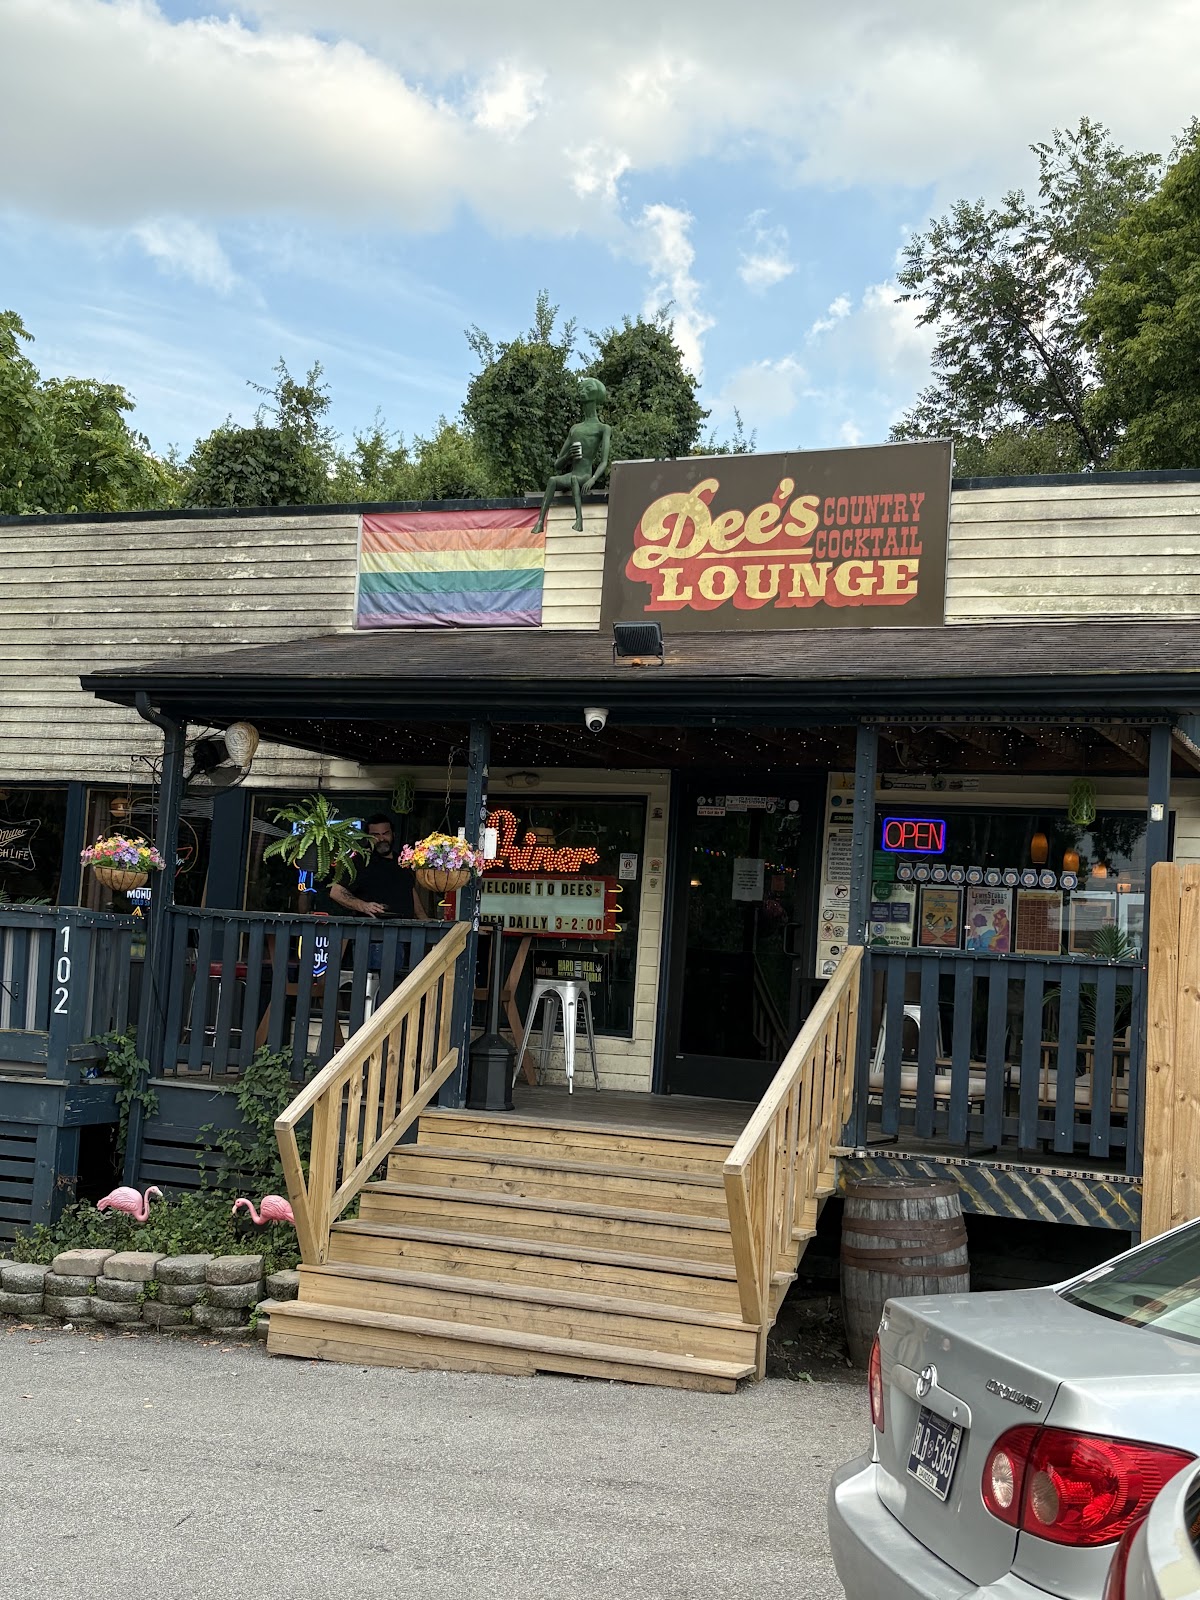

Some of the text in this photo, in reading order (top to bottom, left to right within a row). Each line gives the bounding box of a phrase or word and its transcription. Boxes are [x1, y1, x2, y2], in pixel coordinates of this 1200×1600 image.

[628, 477, 821, 572] Dee's
[823, 492, 926, 526] COUNTRY
[816, 525, 923, 559] COCKTAIL
[652, 558, 920, 604] LOUNGE
[885, 821, 944, 850] OPEN
[10, 848, 29, 860] LIFE
[537, 883, 555, 895] TO
[561, 883, 593, 896] DEES
[508, 915, 548, 929] DAILY
[555, 917, 602, 931] 3-2:00
[54, 925, 71, 1014] 102
[557, 960, 574, 972] HARD
